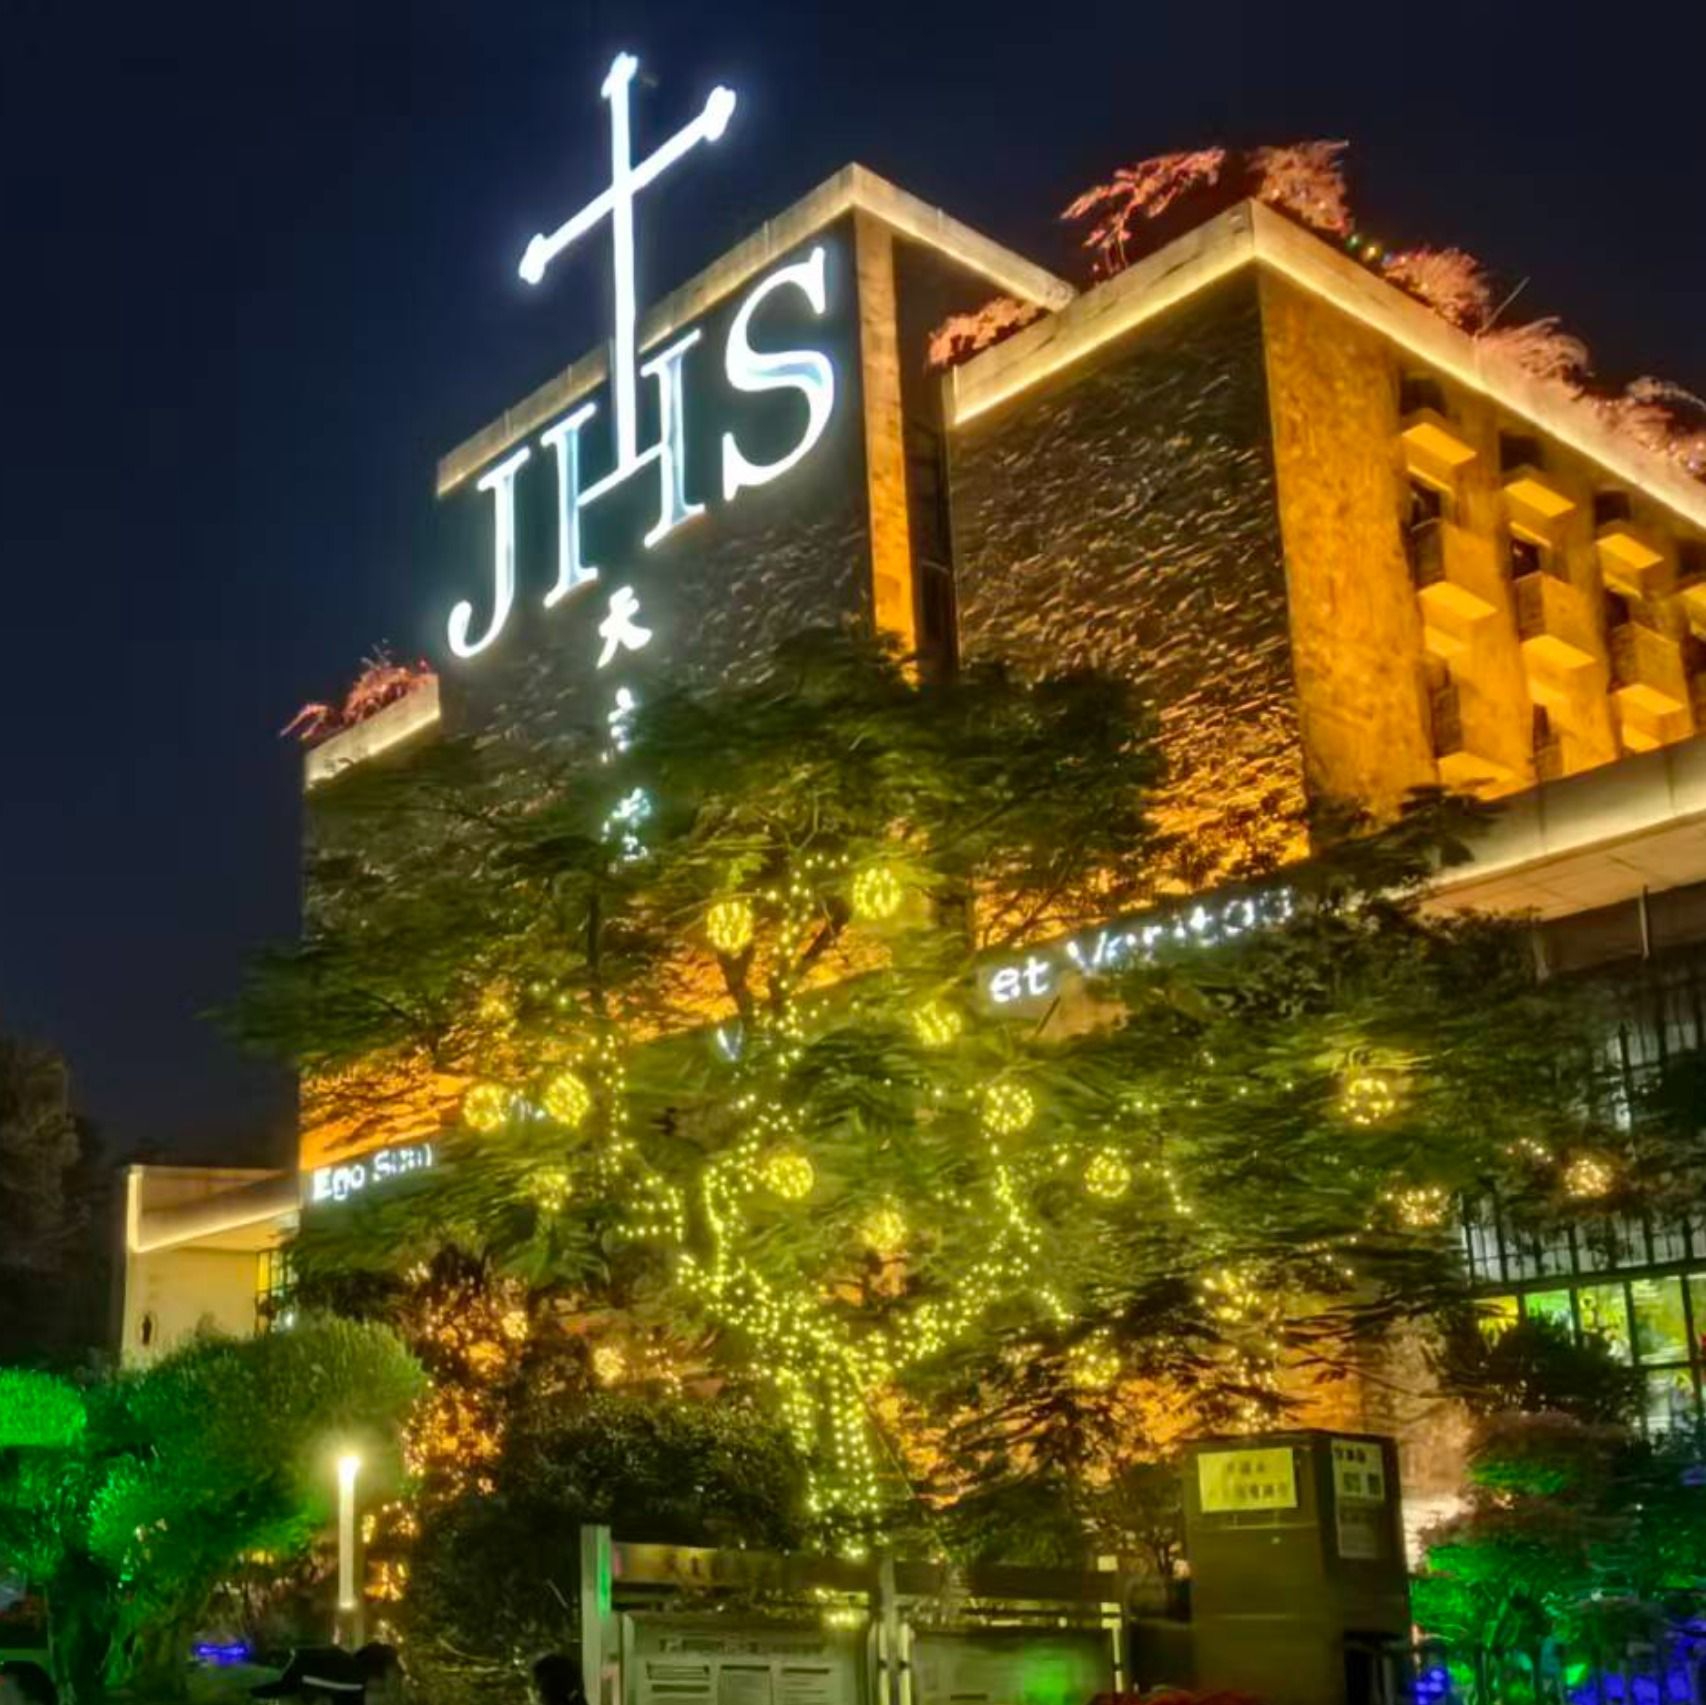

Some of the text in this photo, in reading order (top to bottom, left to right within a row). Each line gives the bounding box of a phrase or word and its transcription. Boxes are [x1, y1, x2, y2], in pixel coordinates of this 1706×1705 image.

[447, 246, 836, 658] JHS
[989, 956, 1050, 1003] et
[312, 1164, 366, 1202] Ego
